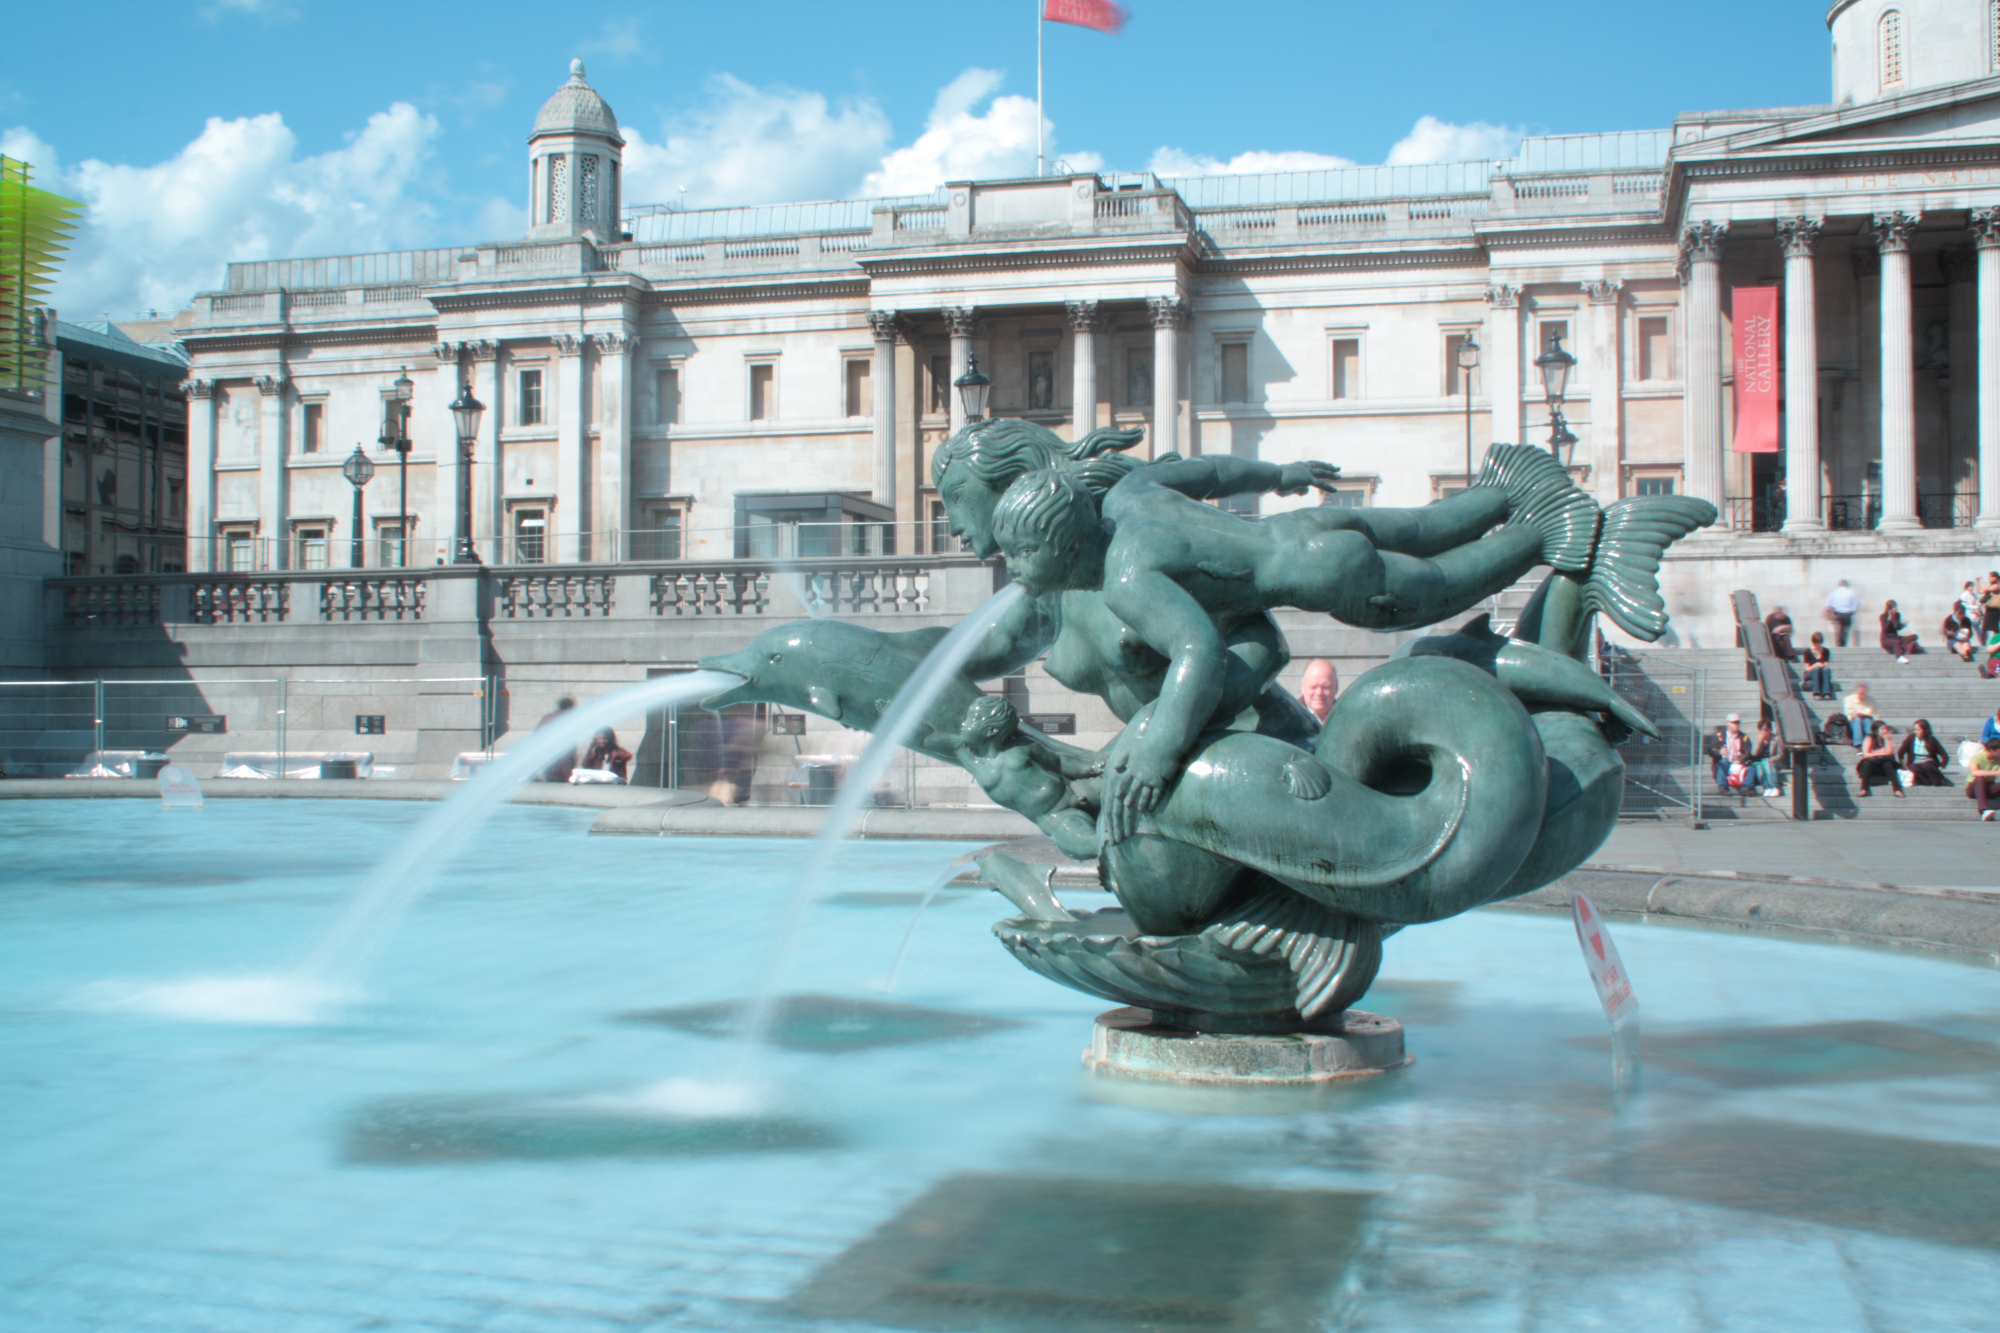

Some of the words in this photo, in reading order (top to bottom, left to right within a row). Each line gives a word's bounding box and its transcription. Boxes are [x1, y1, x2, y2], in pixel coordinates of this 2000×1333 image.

[1840, 173, 1898, 189] THE
[1921, 169, 1995, 186] NATI
[1745, 315, 1756, 393] NATIONAL
[1758, 315, 1771, 393] GALLERY
